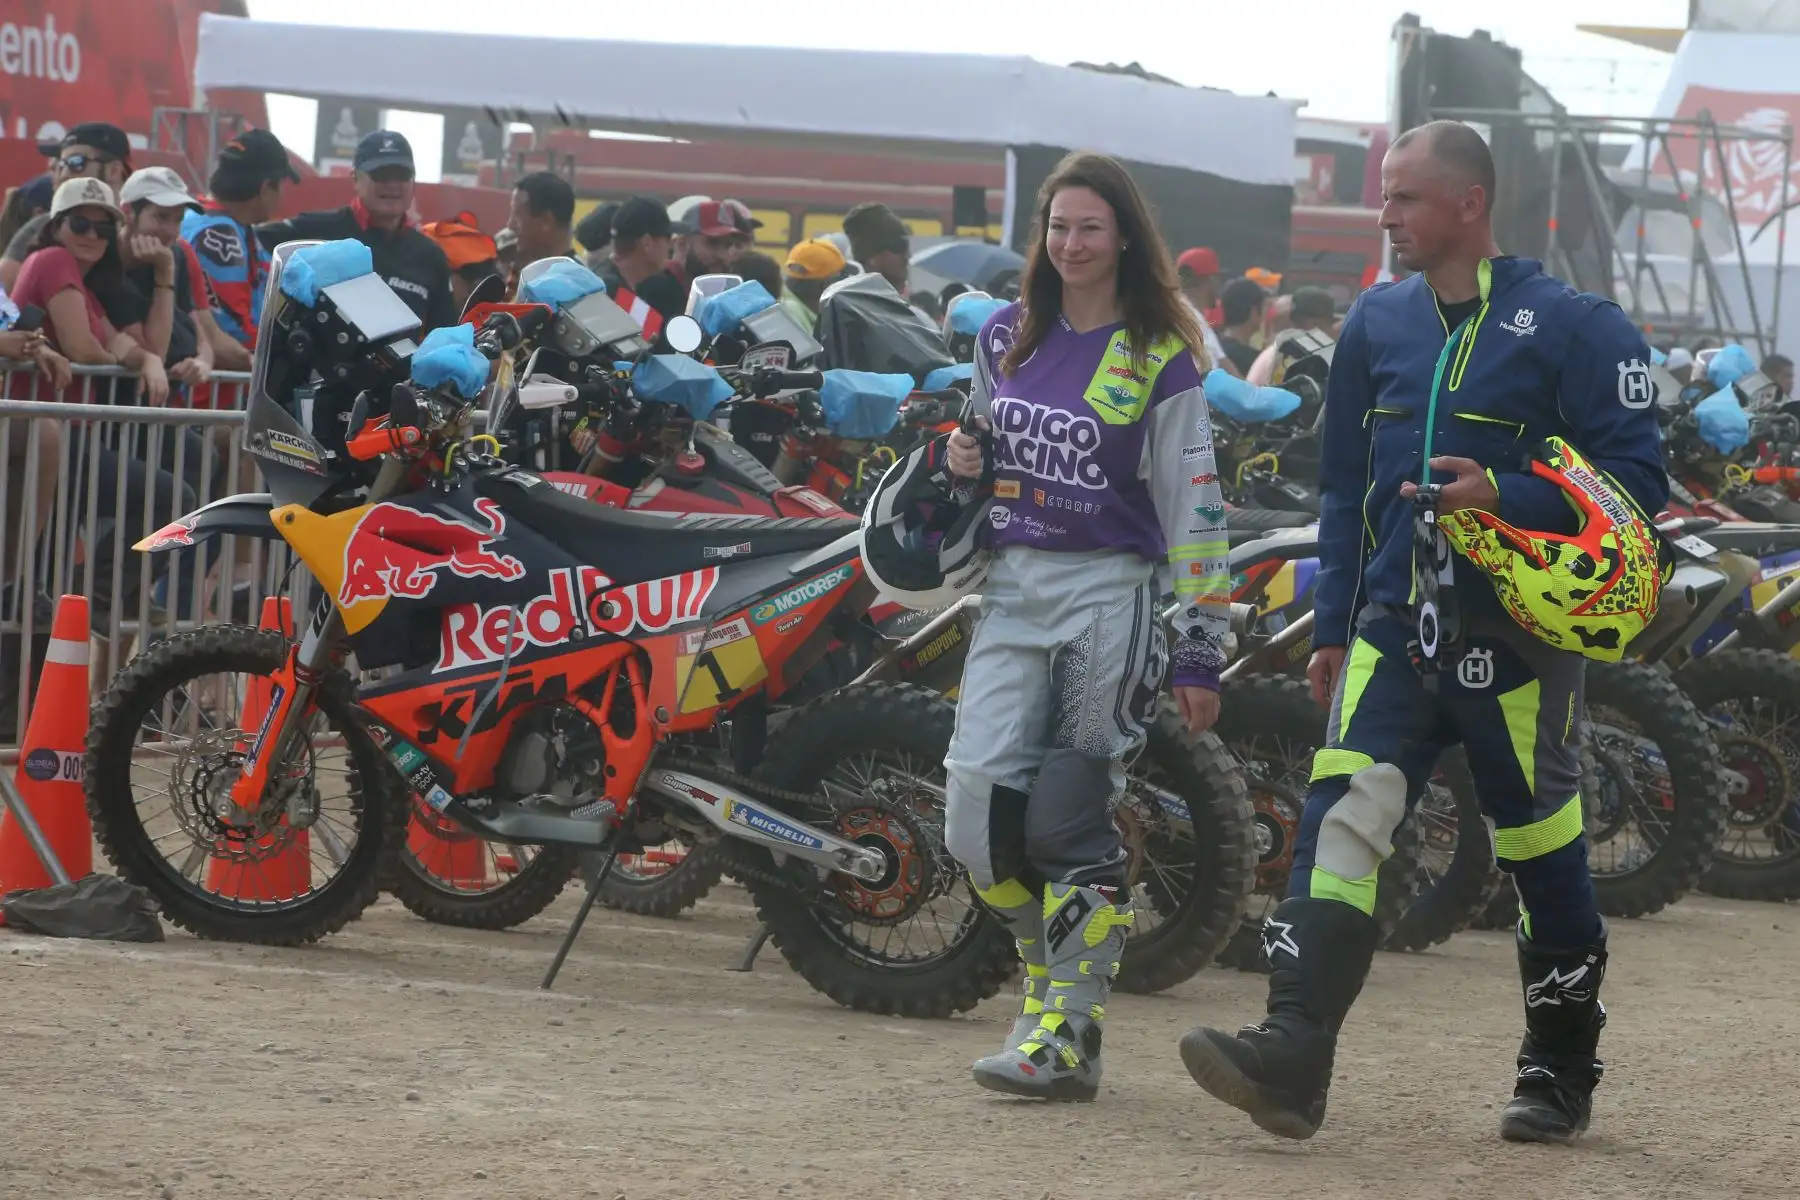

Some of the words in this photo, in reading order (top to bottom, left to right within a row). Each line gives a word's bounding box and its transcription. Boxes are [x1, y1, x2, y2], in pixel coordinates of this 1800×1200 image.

[990, 397, 1101, 454] NDIGO
[991, 433, 1109, 489] ACING
[1182, 444, 1207, 457] Platon
[1048, 495, 1102, 514] CYRRUS
[1600, 498, 1628, 526] PNEU
[774, 567, 850, 613] MOTOREX
[432, 567, 578, 674] Red
[577, 565, 720, 637] Bull
[698, 651, 742, 702] 1
[413, 669, 568, 744] KTM
[751, 816, 815, 846] MICHELIN
